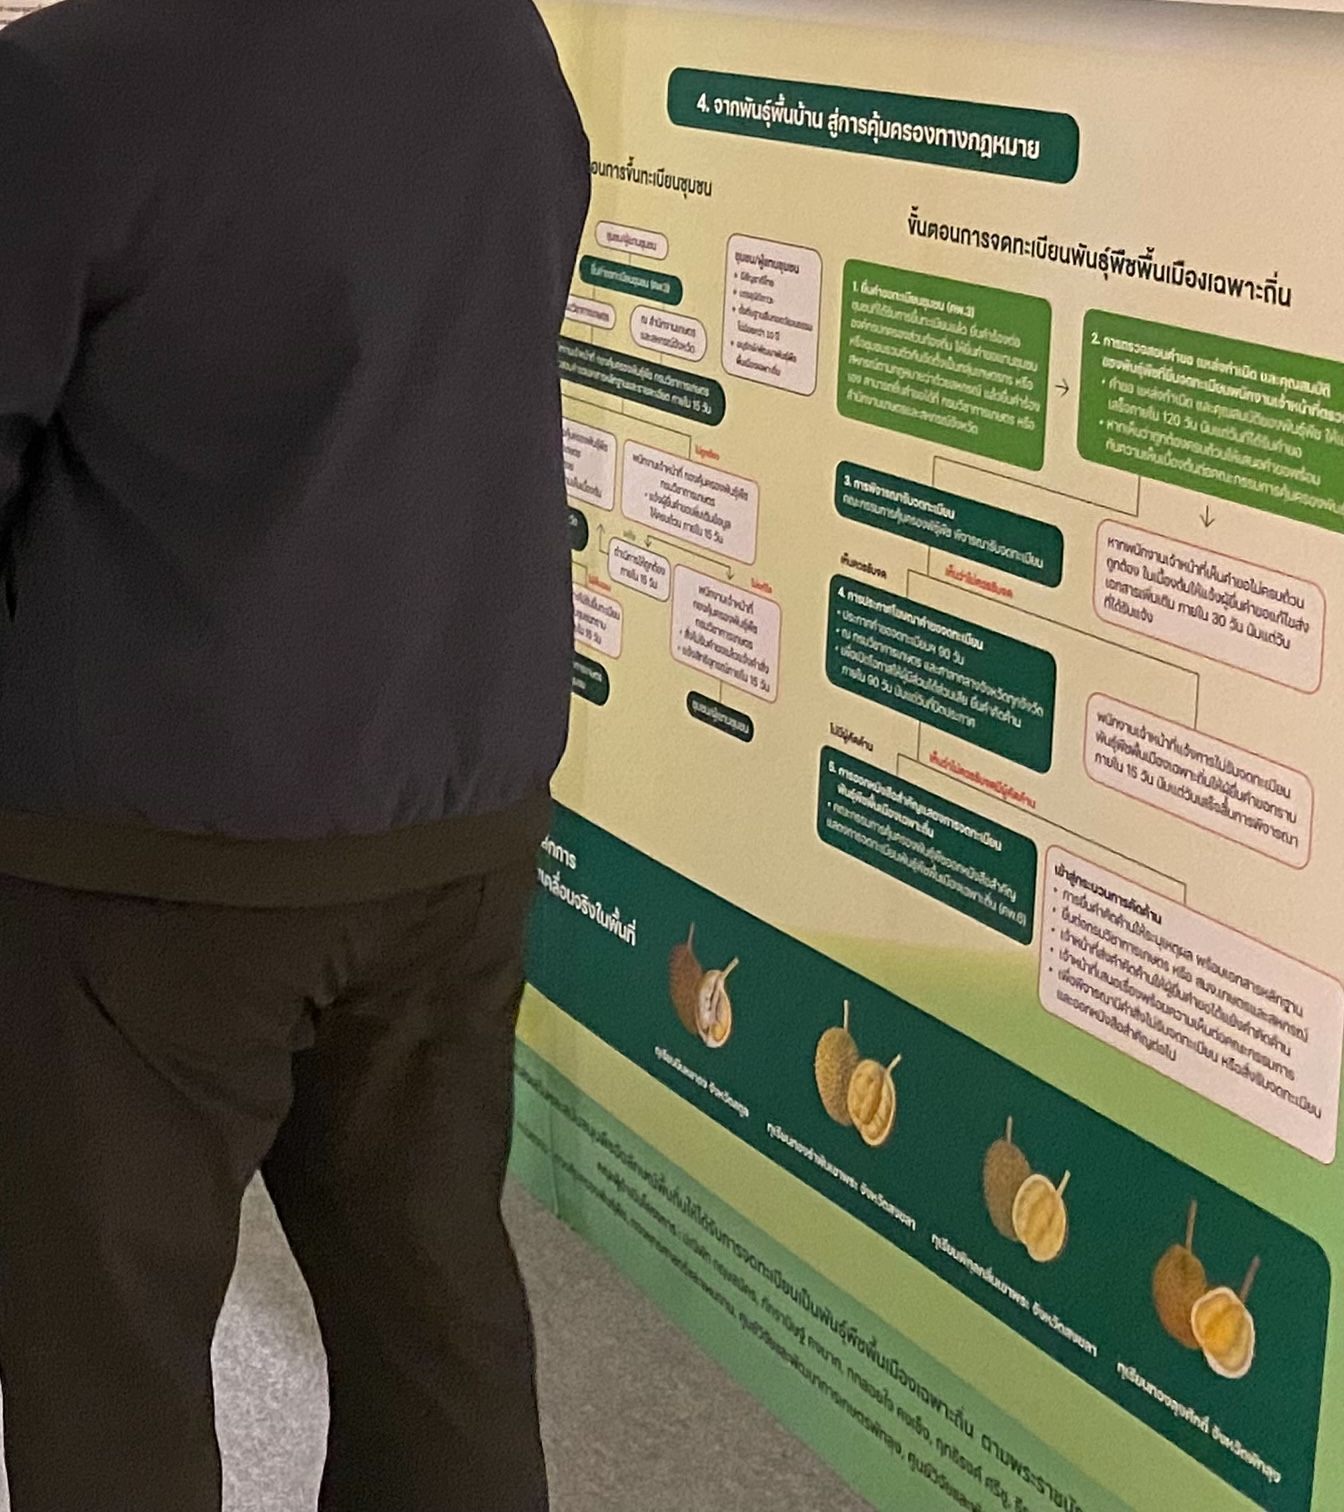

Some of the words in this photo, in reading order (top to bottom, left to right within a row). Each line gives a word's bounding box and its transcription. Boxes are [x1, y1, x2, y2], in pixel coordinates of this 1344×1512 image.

[696, 92, 710, 113] 4.
[714, 93, 823, 130] จากพันธุ์พื้นบ้าน
[827, 106, 1040, 160] สู่การคุ้มครองทางกฎหมาย
[908, 206, 1293, 307] ขั้นตอนการจดทะเบียนพันธุ์พืชพื้นเมืองเฉพาะถิ่น
